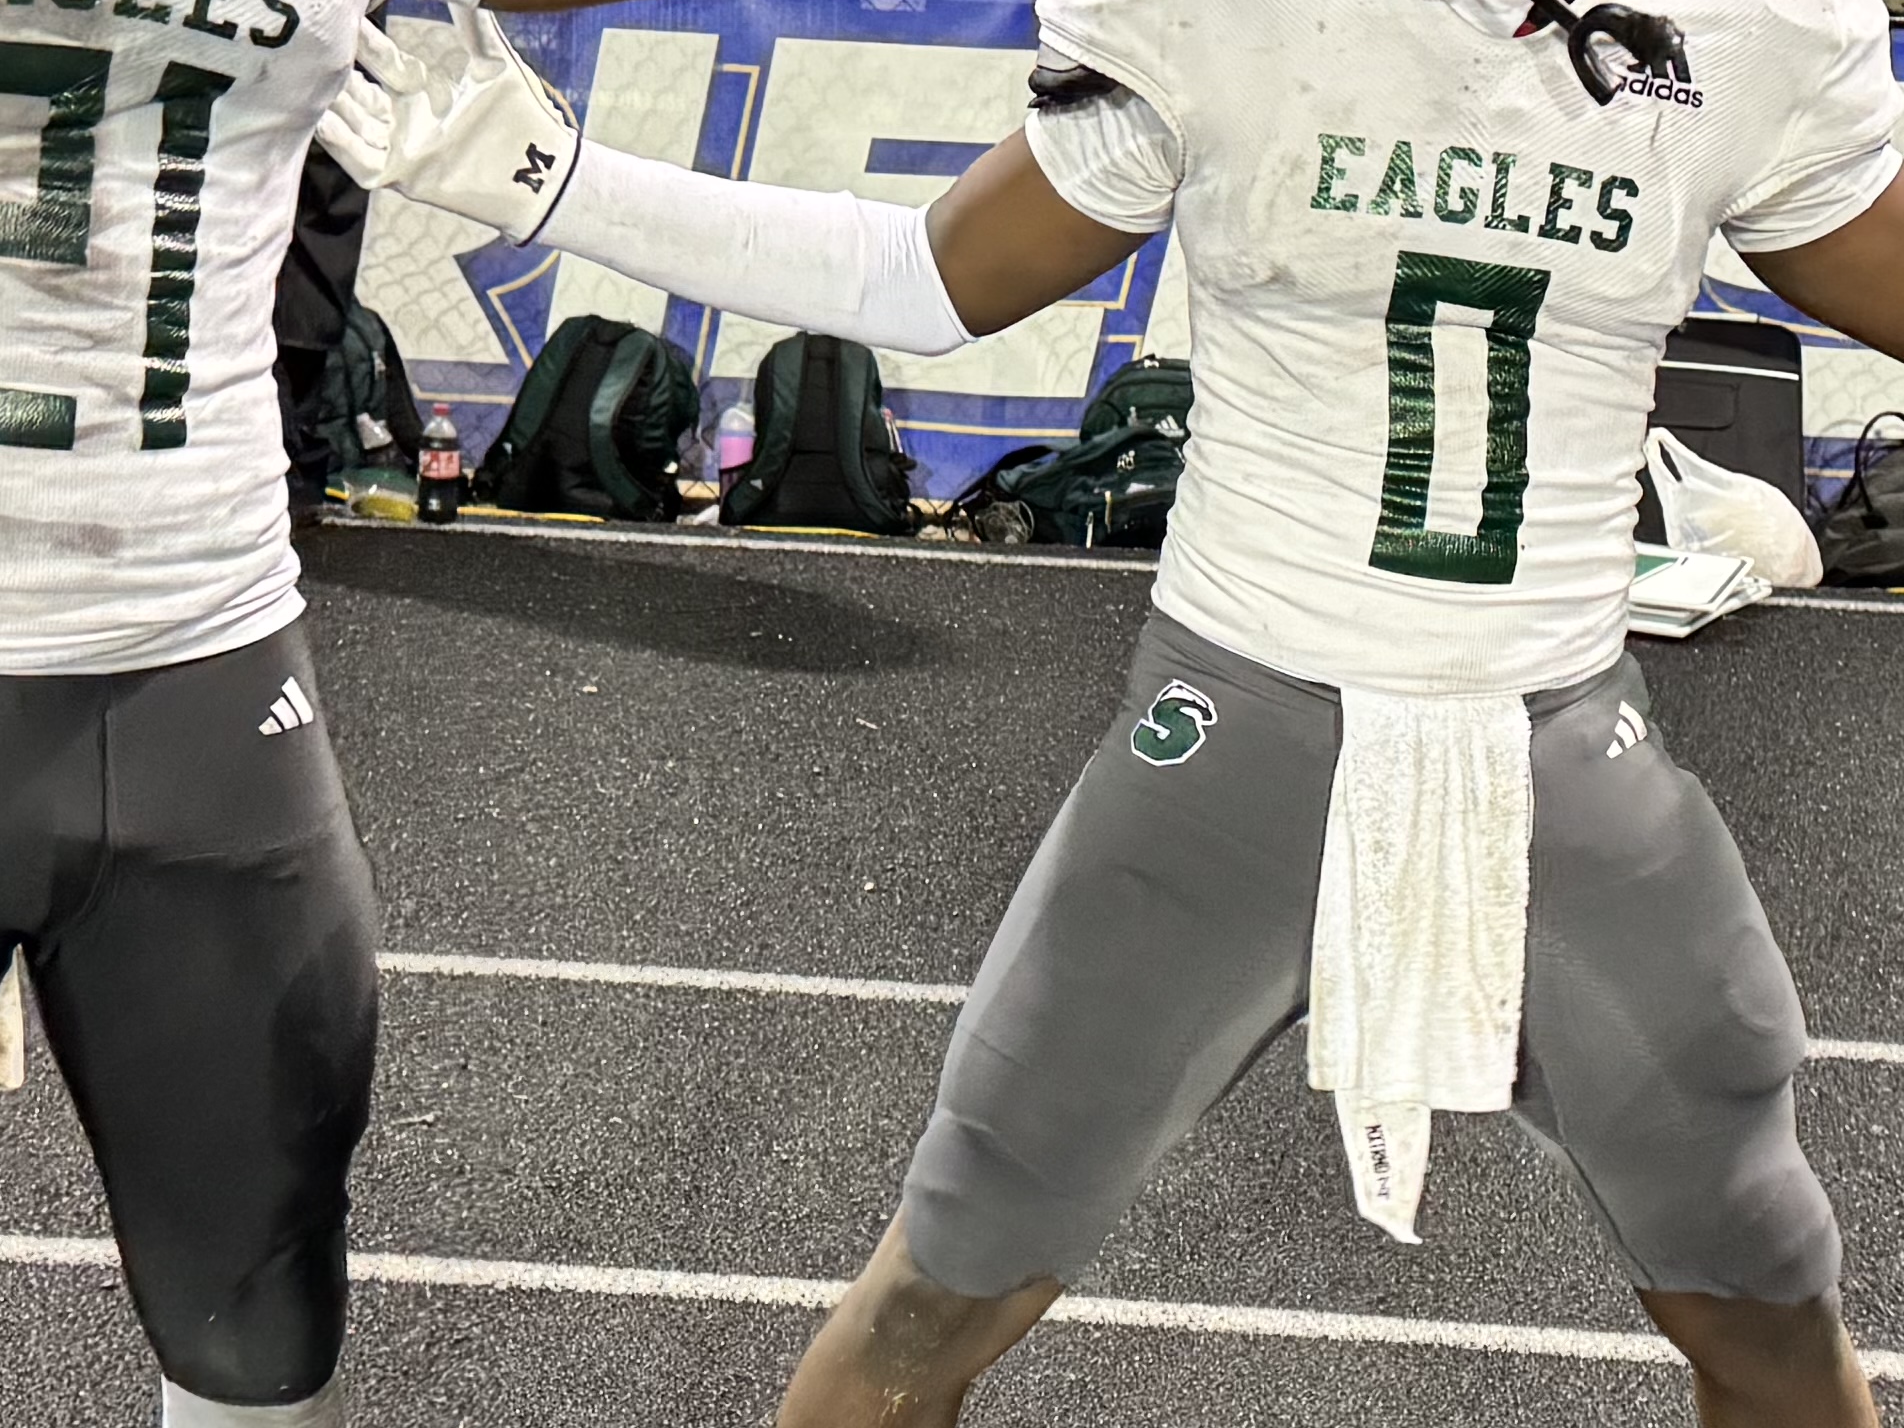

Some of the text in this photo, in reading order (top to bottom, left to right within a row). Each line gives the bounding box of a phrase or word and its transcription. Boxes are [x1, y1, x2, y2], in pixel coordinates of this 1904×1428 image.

[512, 142, 557, 194] M
[1310, 133, 1640, 253] EAGLES
[1368, 249, 1553, 585] 0
